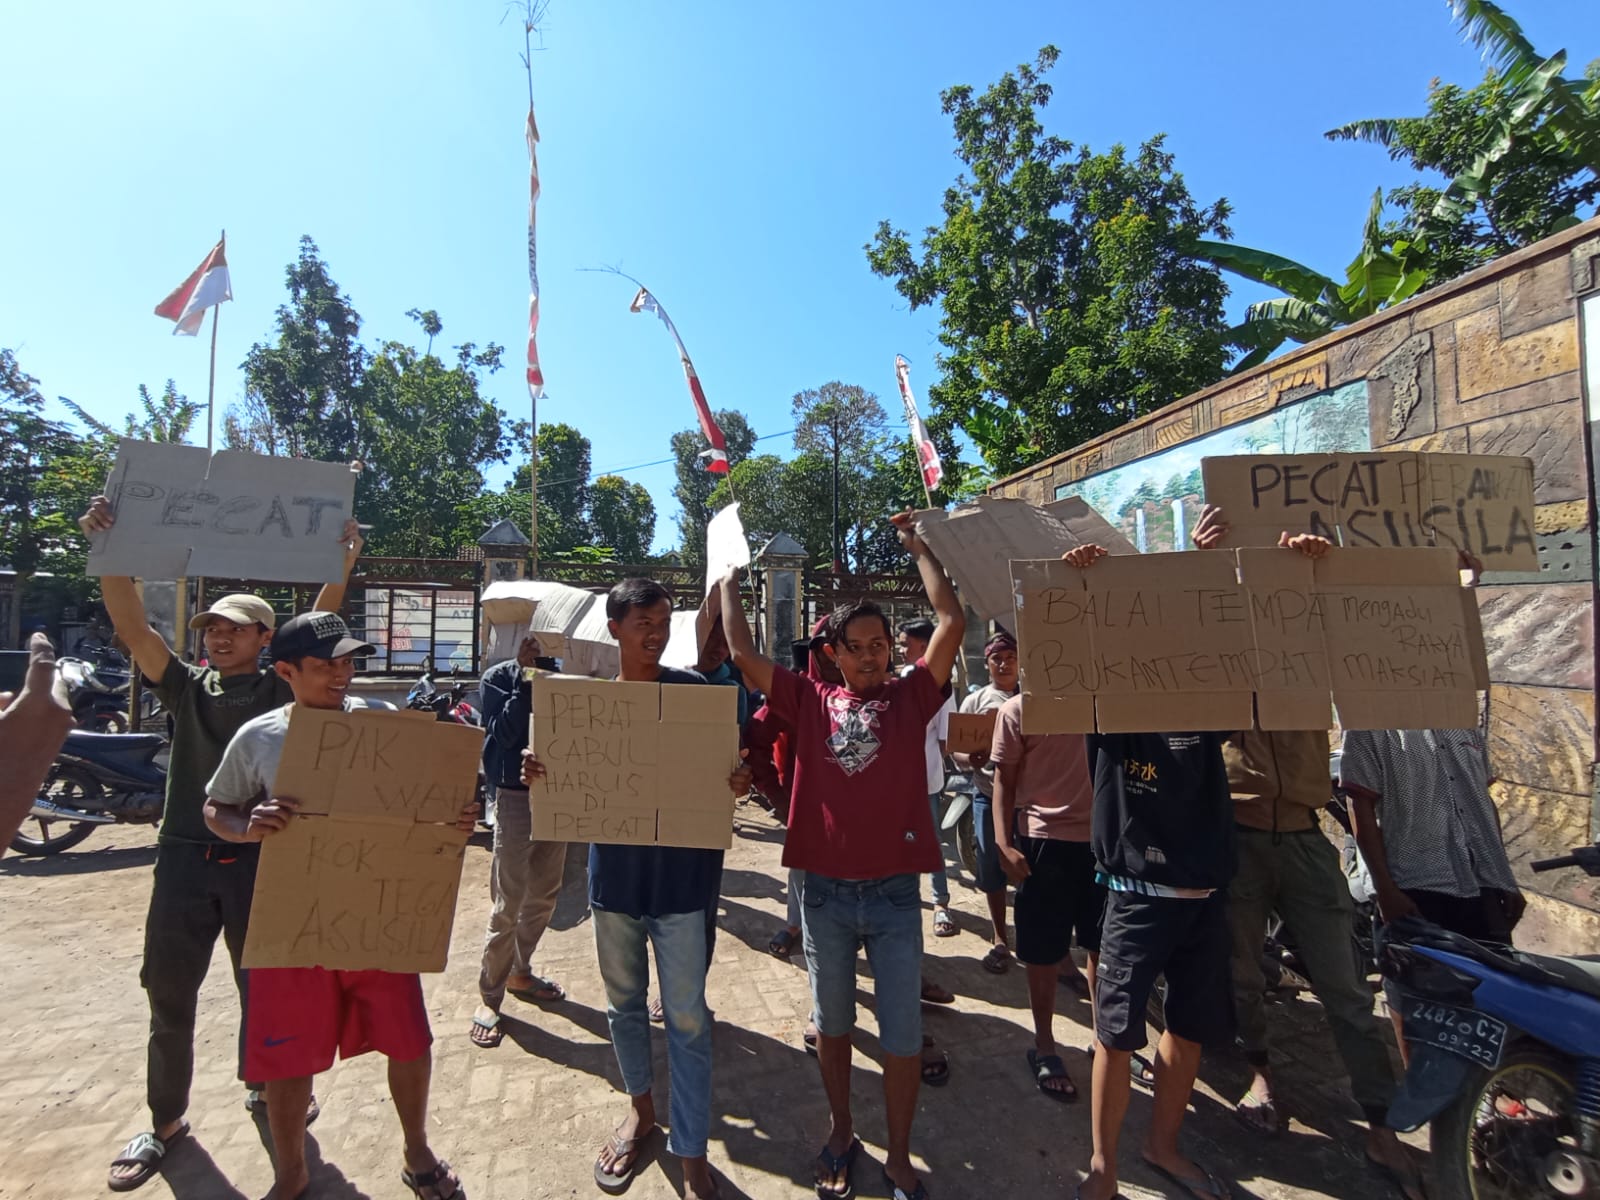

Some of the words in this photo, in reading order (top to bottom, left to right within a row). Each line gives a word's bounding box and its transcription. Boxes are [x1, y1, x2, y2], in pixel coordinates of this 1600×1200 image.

[1250, 459, 1388, 508] PECAT
[102, 478, 344, 553] PECAT
[1038, 586, 1163, 627] BALAI
[1343, 653, 1467, 688] MAKSIAT
[550, 691, 638, 734] PERAT
[312, 719, 400, 772] PAK
[547, 736, 656, 767] CABUL
[584, 793, 607, 812] DI
[553, 812, 651, 839] PECAT
[306, 835, 380, 874] KOK
[1412, 1003, 1457, 1027] 2482
[1475, 1018, 1501, 1046] CZ
